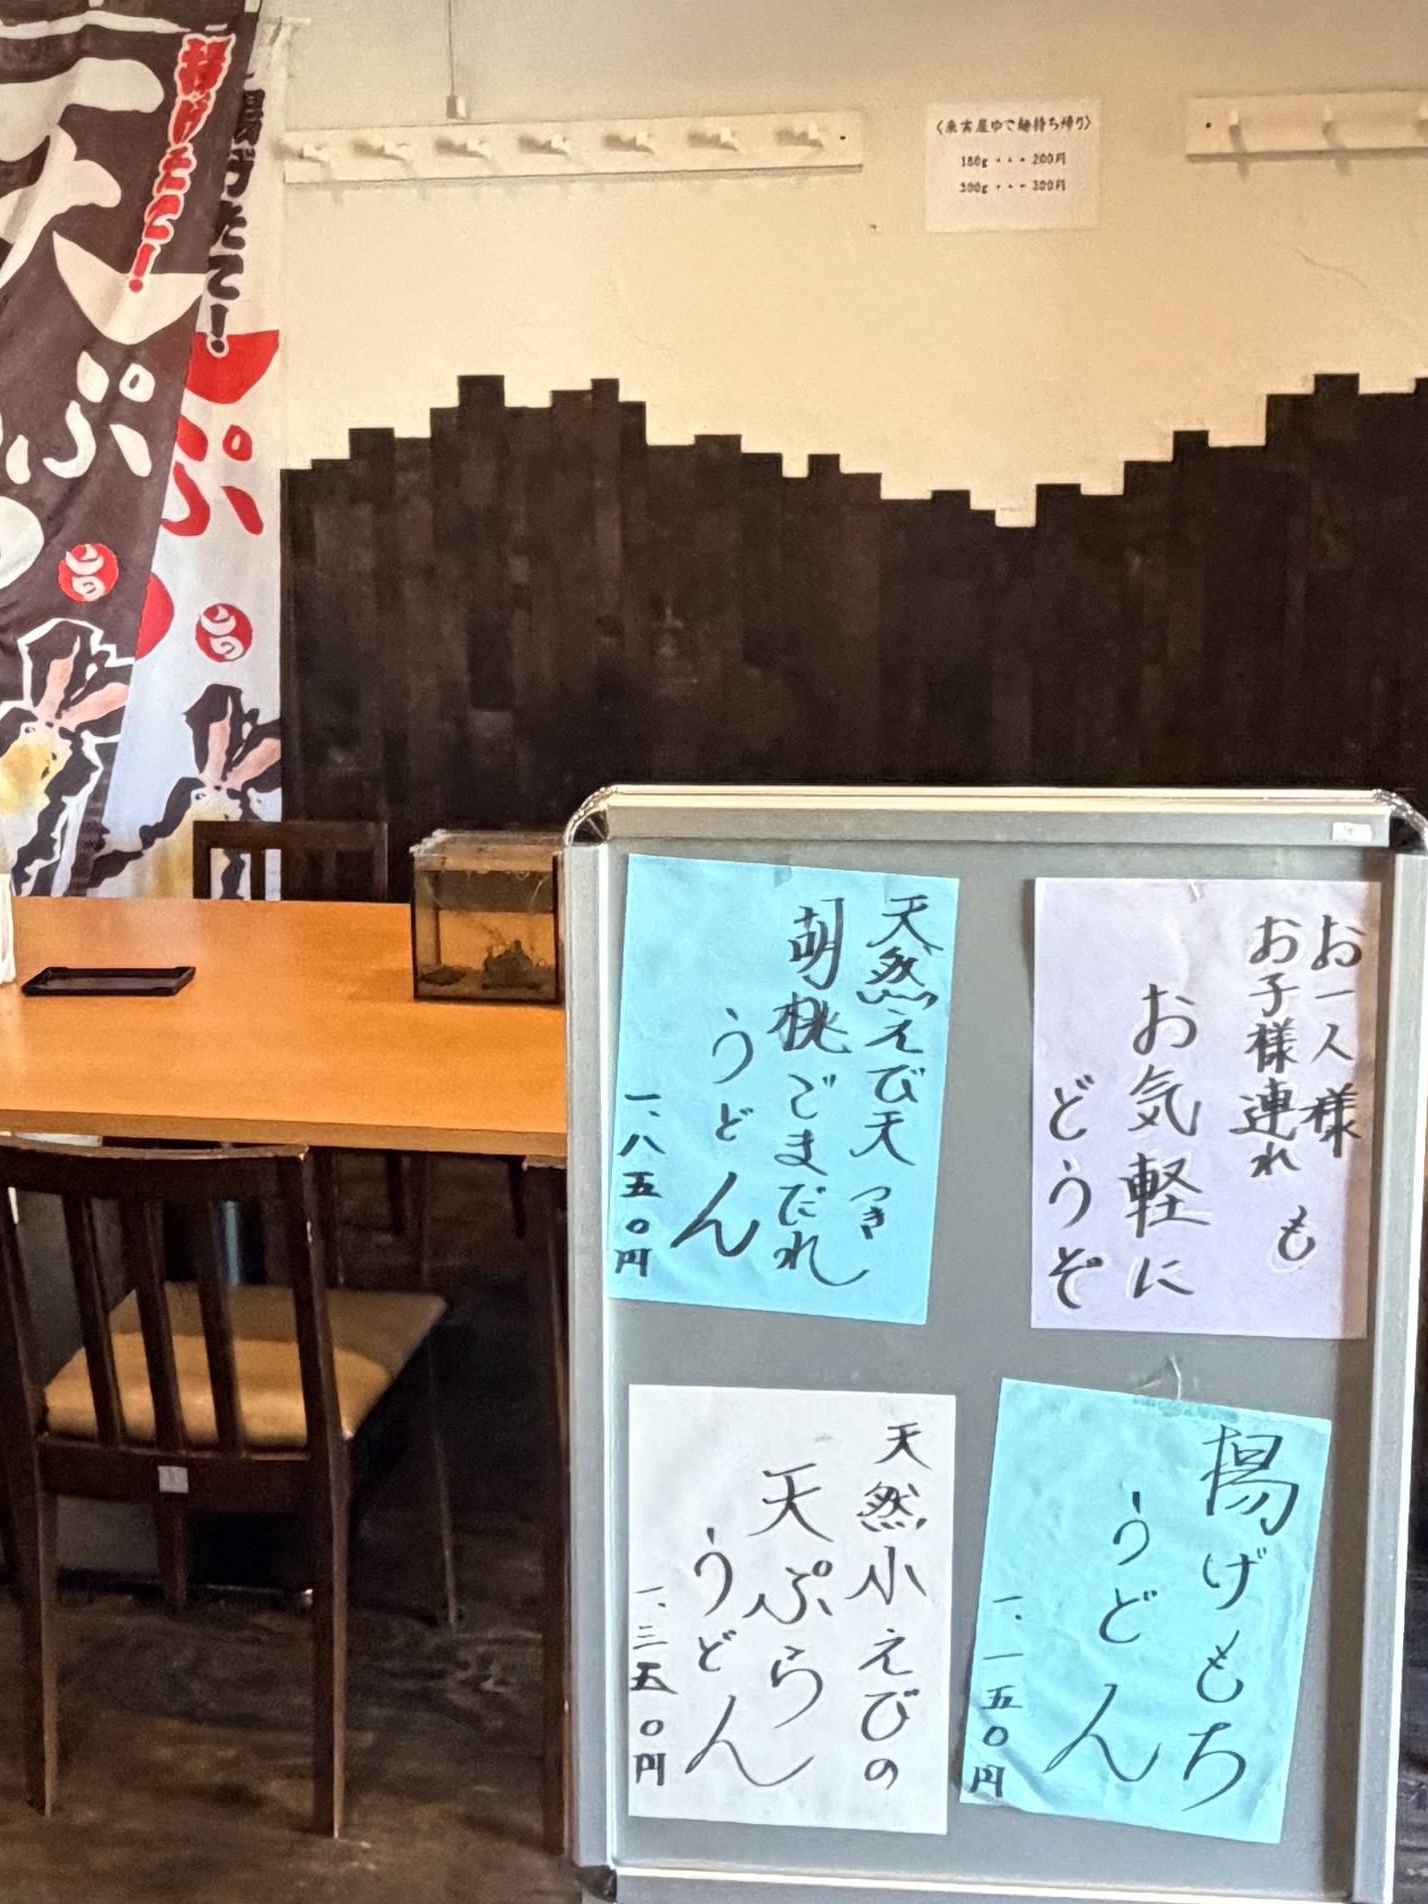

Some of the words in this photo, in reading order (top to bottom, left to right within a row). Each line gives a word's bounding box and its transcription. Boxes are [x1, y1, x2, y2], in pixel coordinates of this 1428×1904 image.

[670, 1008, 760, 1258] うどん
[766, 897, 870, 1287] 胡桃ごまだれ
[850, 894, 944, 1240] 天然えび天つき
[1119, 982, 1212, 1299] お気軽に
[1229, 915, 1302, 1178] お子様連れ
[1300, 914, 1366, 1159] お一人様
[1048, 1073, 1104, 1310] どうぞ
[1277, 1204, 1316, 1262] も
[684, 1526, 816, 1788] うどん
[741, 1462, 835, 1730] 天ぷら
[844, 1422, 933, 1791] 天然小えびの
[1042, 1490, 1162, 1783] うどん
[1180, 1424, 1300, 1811] 揚げもち
